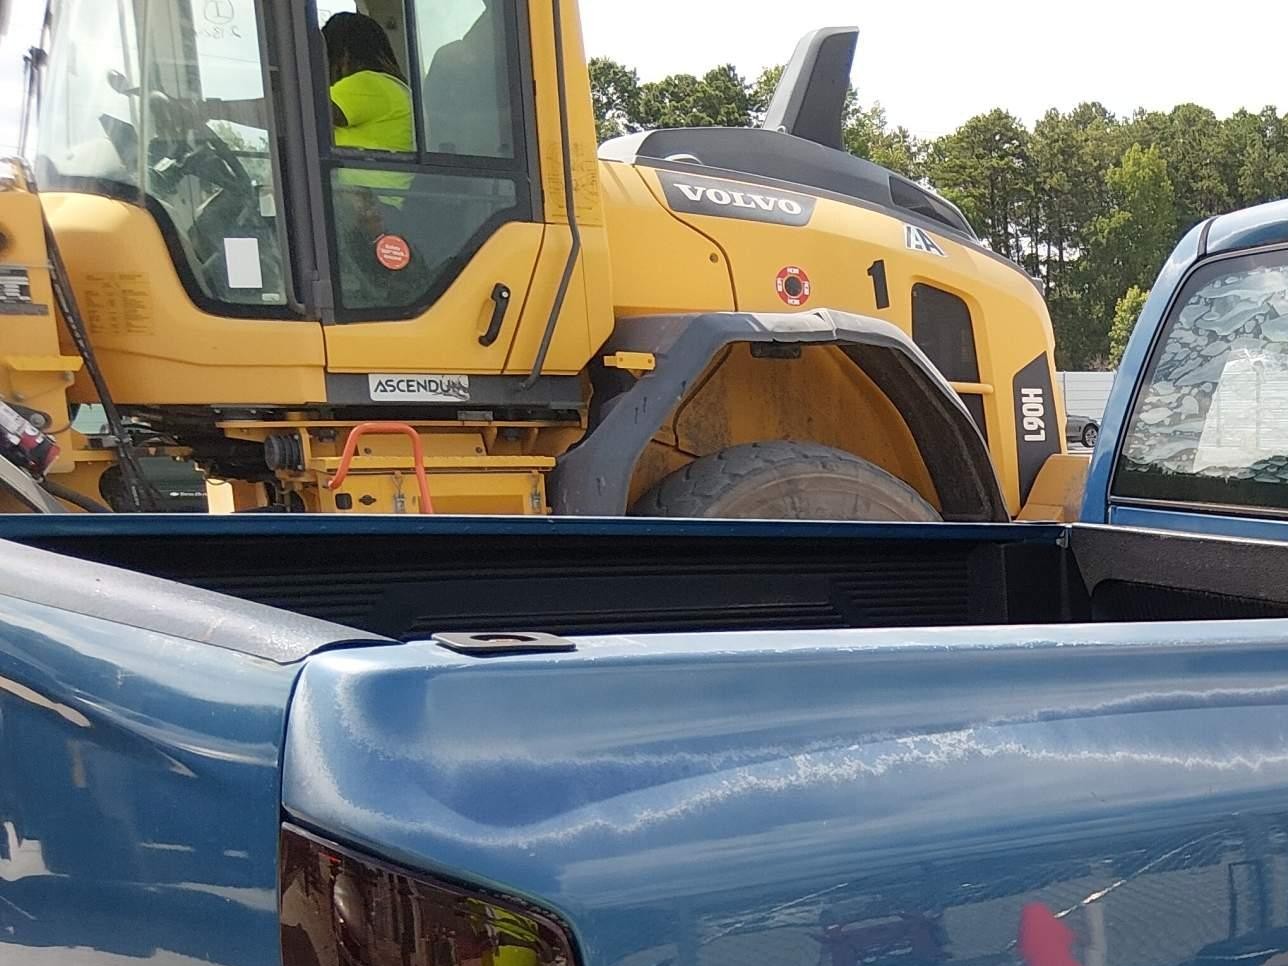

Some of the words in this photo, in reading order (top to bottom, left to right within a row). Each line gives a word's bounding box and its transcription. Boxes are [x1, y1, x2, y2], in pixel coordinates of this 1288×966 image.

[673, 183, 802, 215] VOLVO
[867, 259, 890, 310] 1
[1021, 388, 1046, 442] L90H
